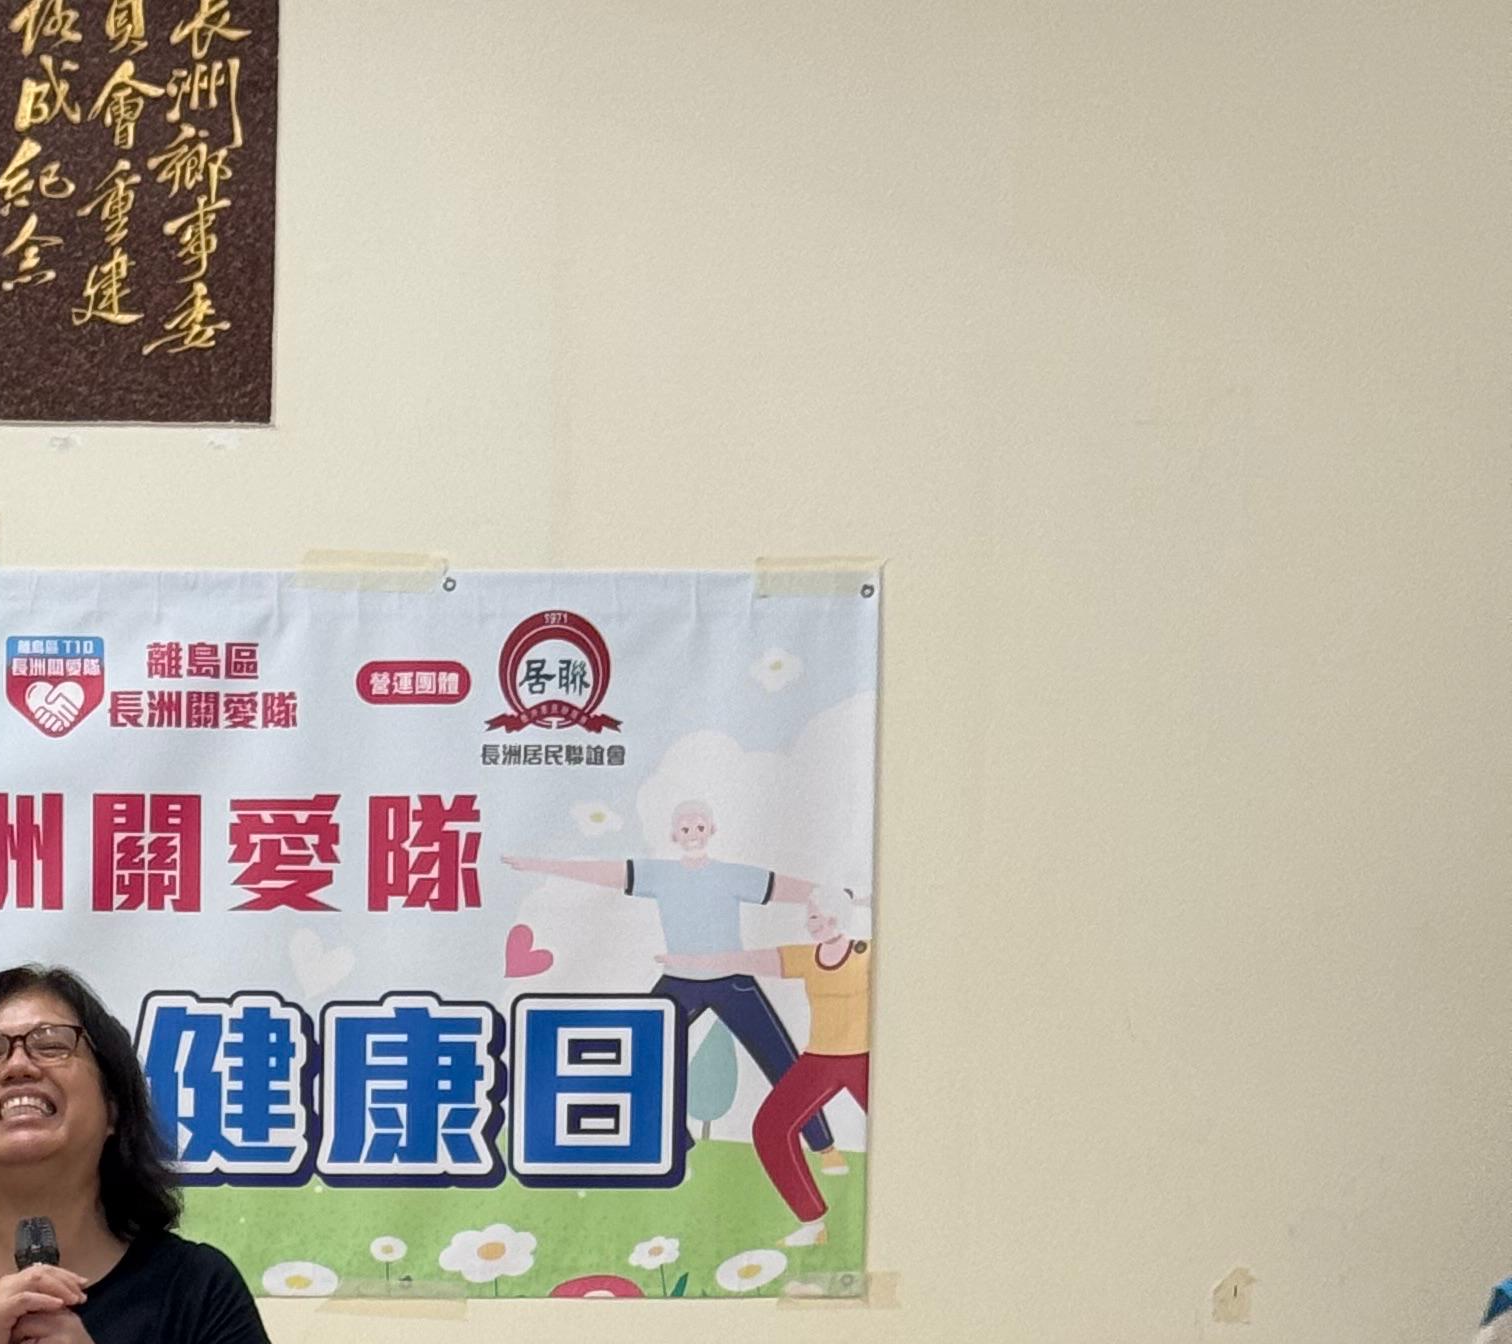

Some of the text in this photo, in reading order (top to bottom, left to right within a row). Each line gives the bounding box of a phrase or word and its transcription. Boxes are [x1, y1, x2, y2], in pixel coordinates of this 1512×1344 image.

[146, 642, 259, 680] 離島區
[369, 671, 461, 696] 營運團體
[109, 690, 298, 729] 長洲關愛隊
[482, 743, 626, 766] 長洲居民聯誼會
